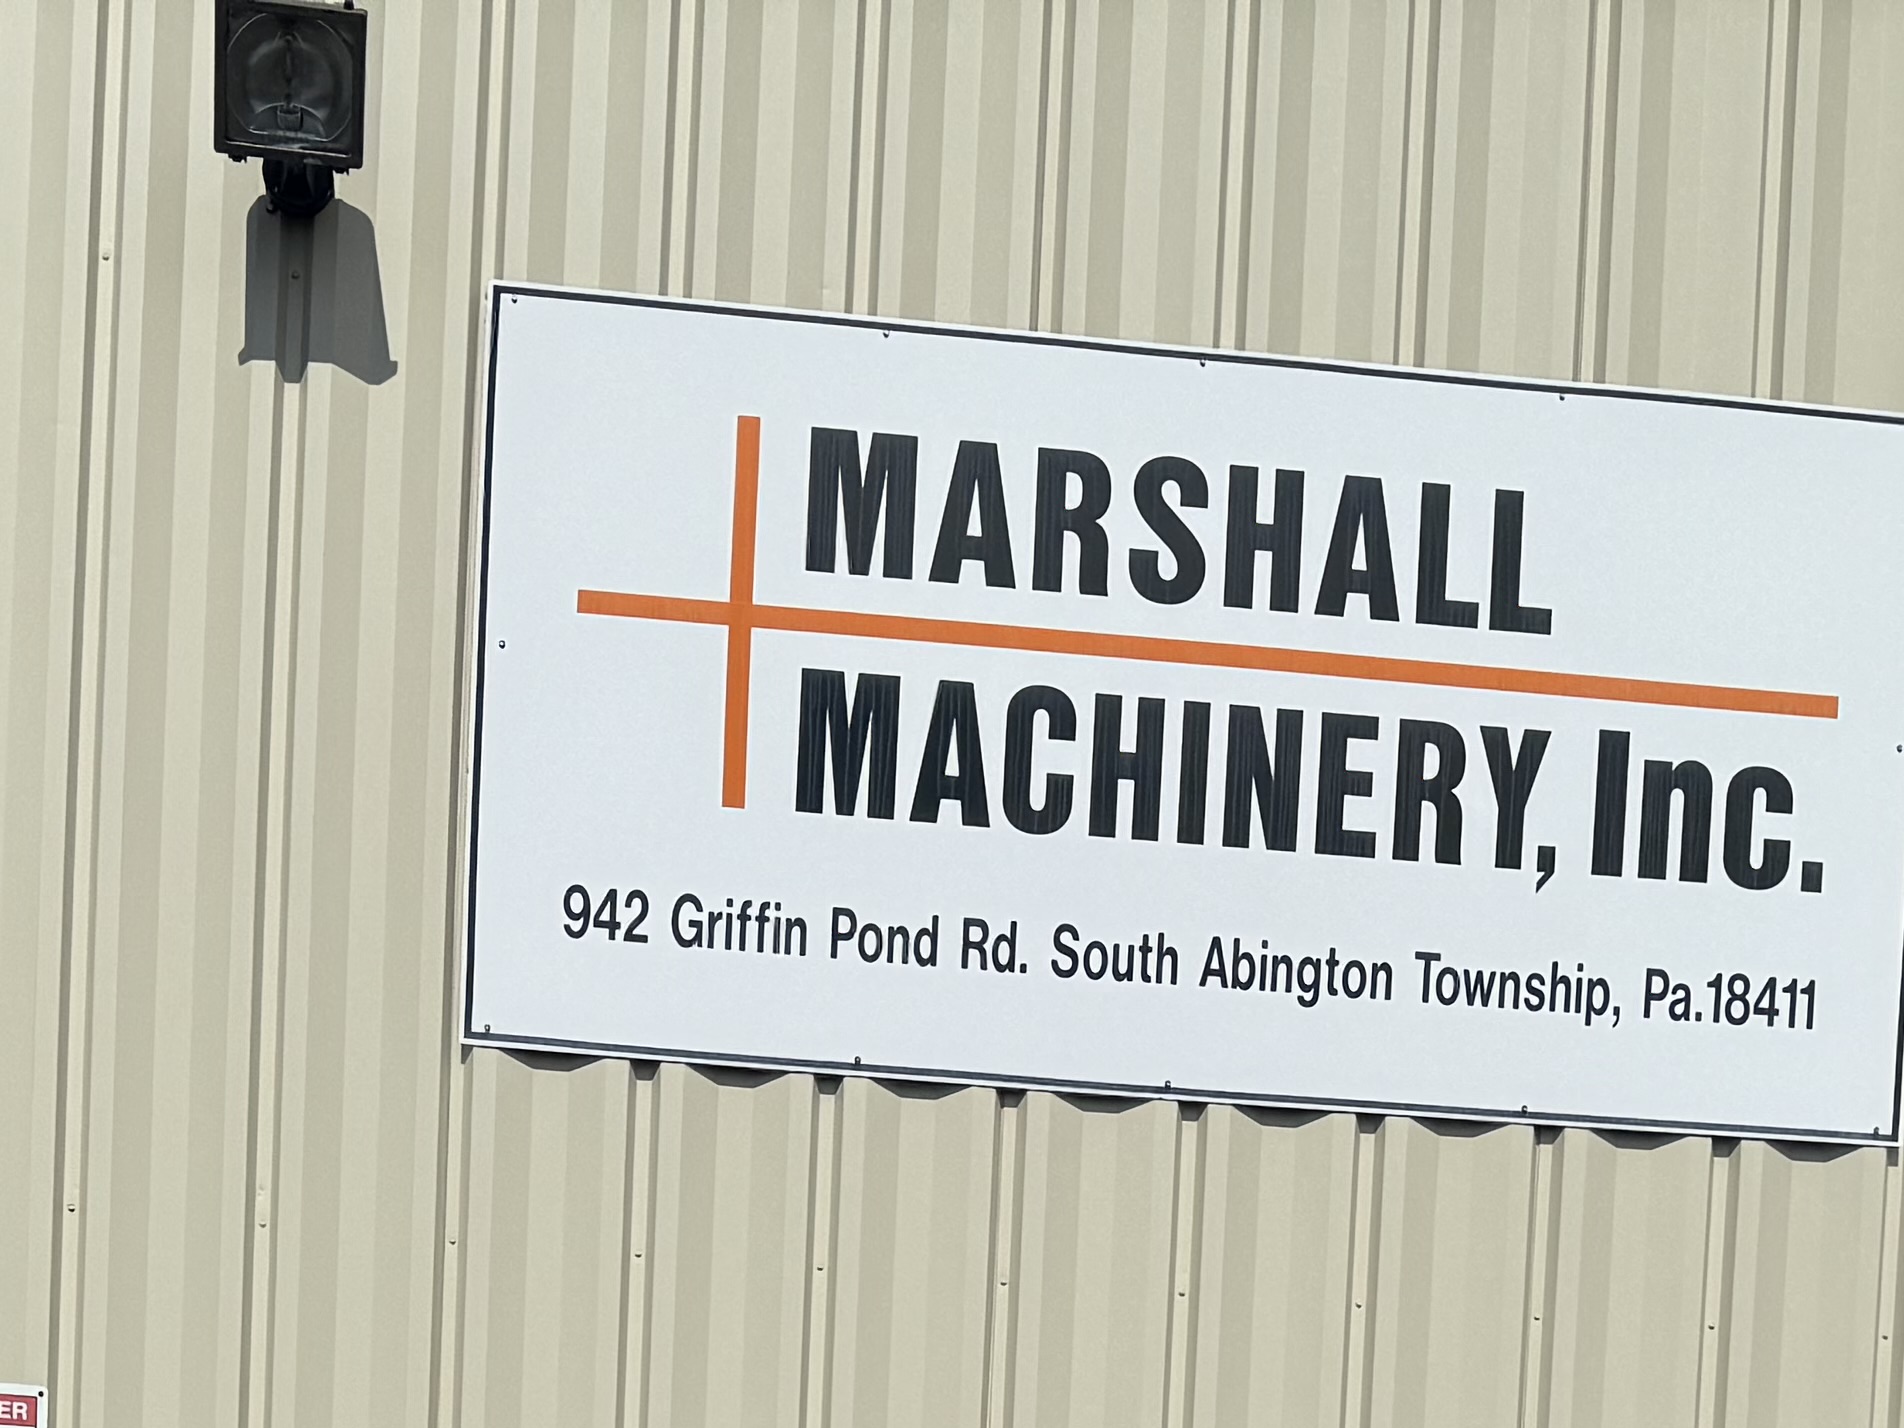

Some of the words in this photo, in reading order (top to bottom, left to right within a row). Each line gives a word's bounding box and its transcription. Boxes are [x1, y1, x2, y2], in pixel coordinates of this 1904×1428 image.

[805, 426, 1553, 636] MARSHALL
[795, 667, 1556, 894] MACHINERY,
[1590, 729, 1824, 894] Inc.
[563, 884, 649, 944] 942
[671, 893, 807, 957] Griffin
[830, 906, 940, 968] Pond
[961, 917, 1031, 975] Rd.
[1050, 923, 1179, 986] South
[1198, 935, 1393, 1008] Abington
[1414, 951, 1621, 1028] Township,
